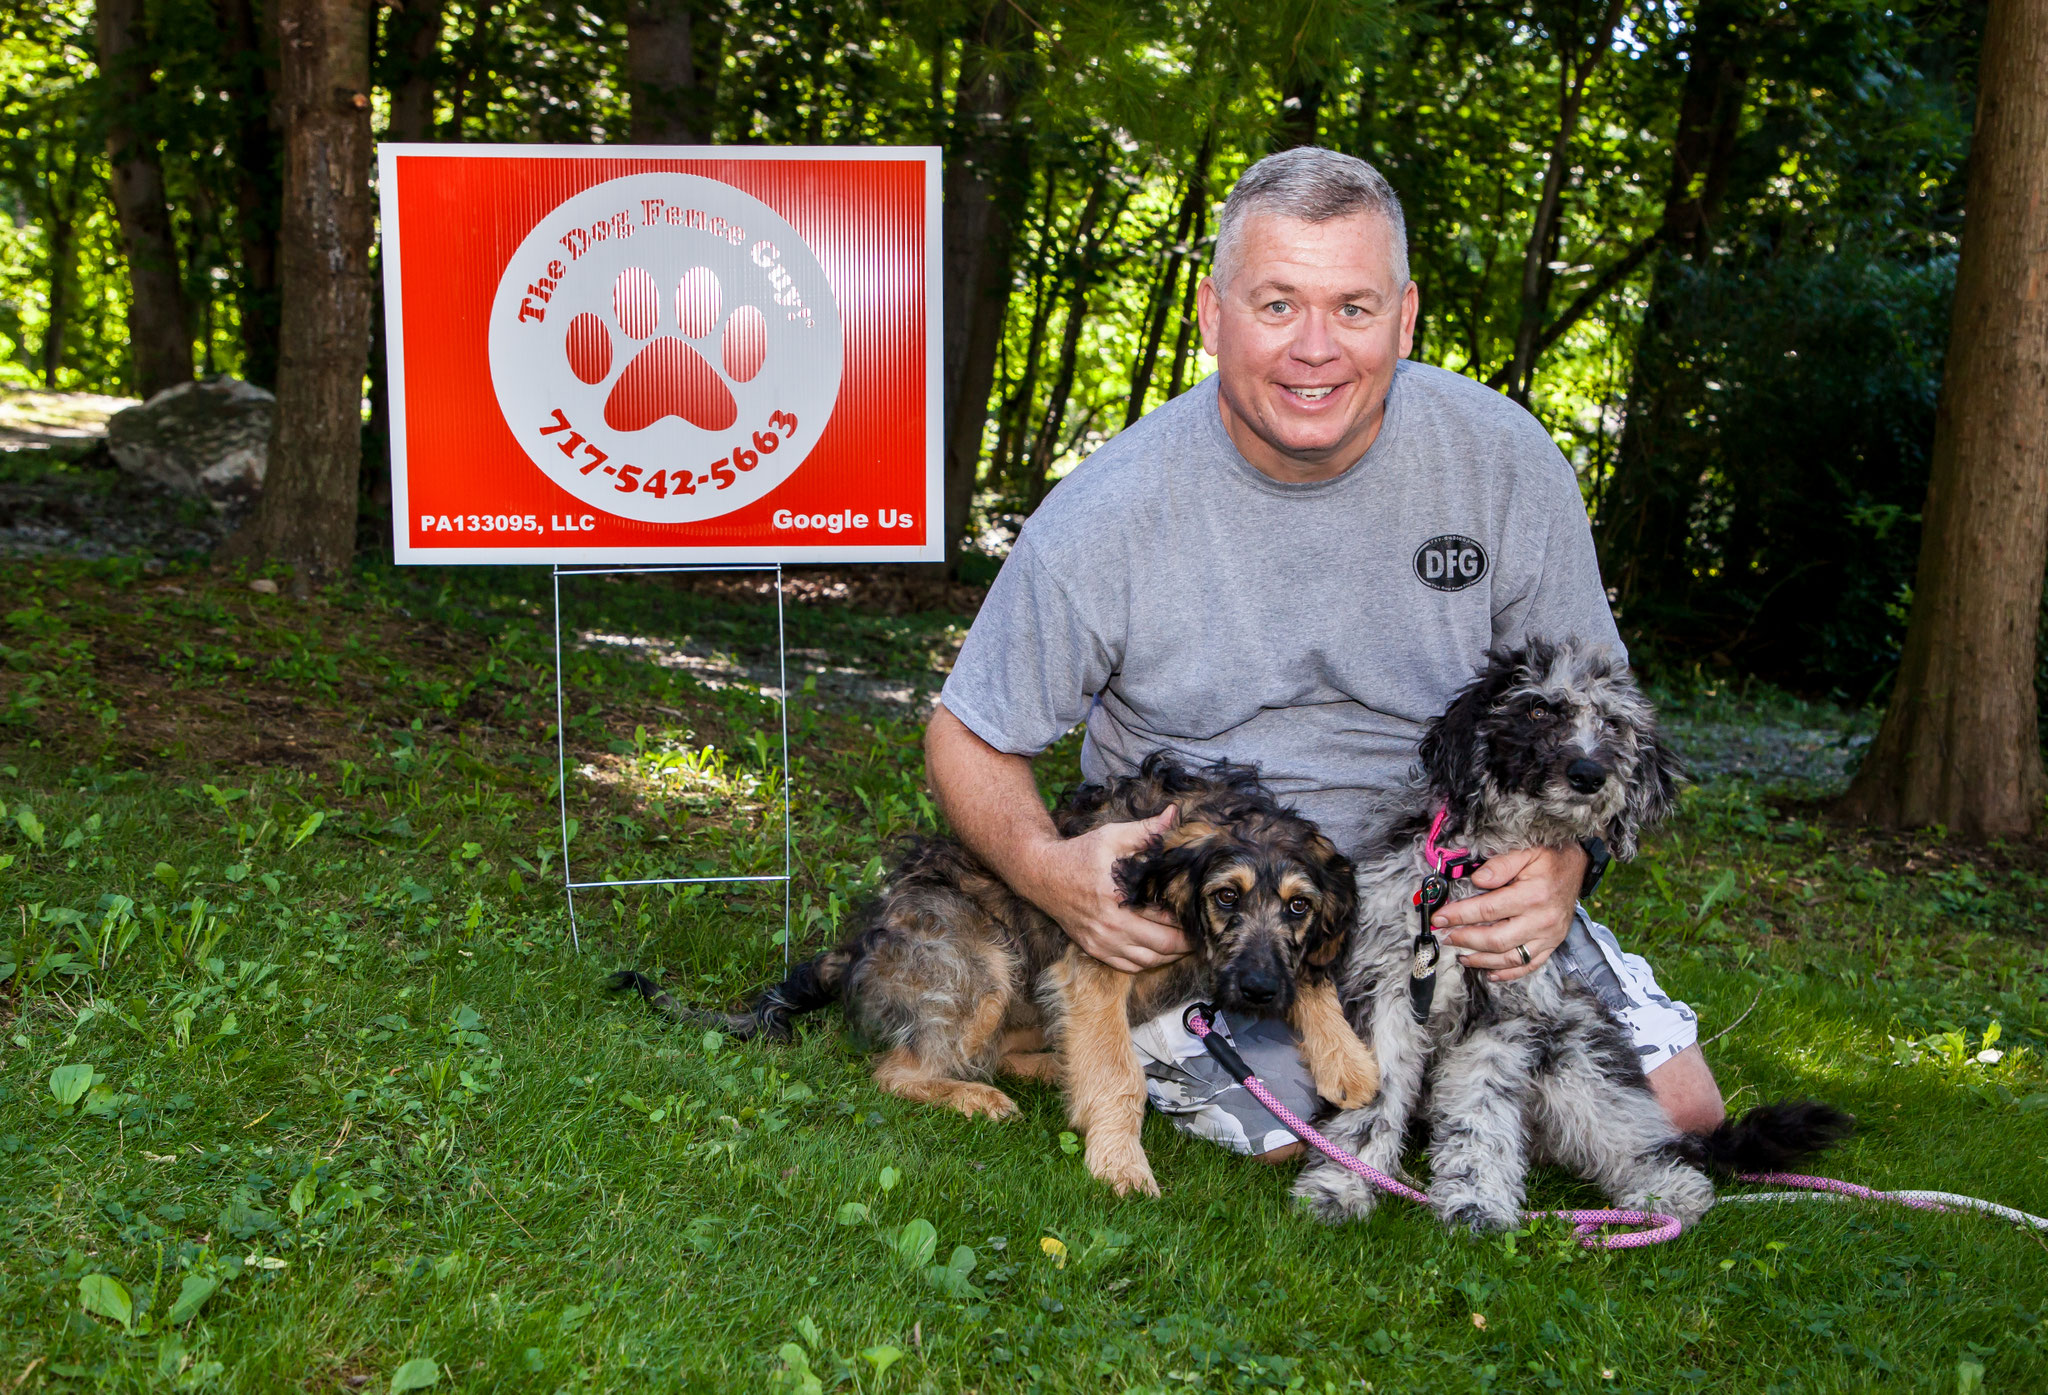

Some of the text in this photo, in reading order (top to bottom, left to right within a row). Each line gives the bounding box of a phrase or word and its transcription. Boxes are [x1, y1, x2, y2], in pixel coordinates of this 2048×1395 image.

[518, 260, 566, 324] The
[559, 209, 636, 261] Dog
[641, 198, 746, 247] Fence
[539, 408, 799, 499] 717-542-5663
[420, 514, 596, 535] PA133095, LLC
[772, 508, 914, 534] Google Us
[1425, 548, 1479, 579] DFG
